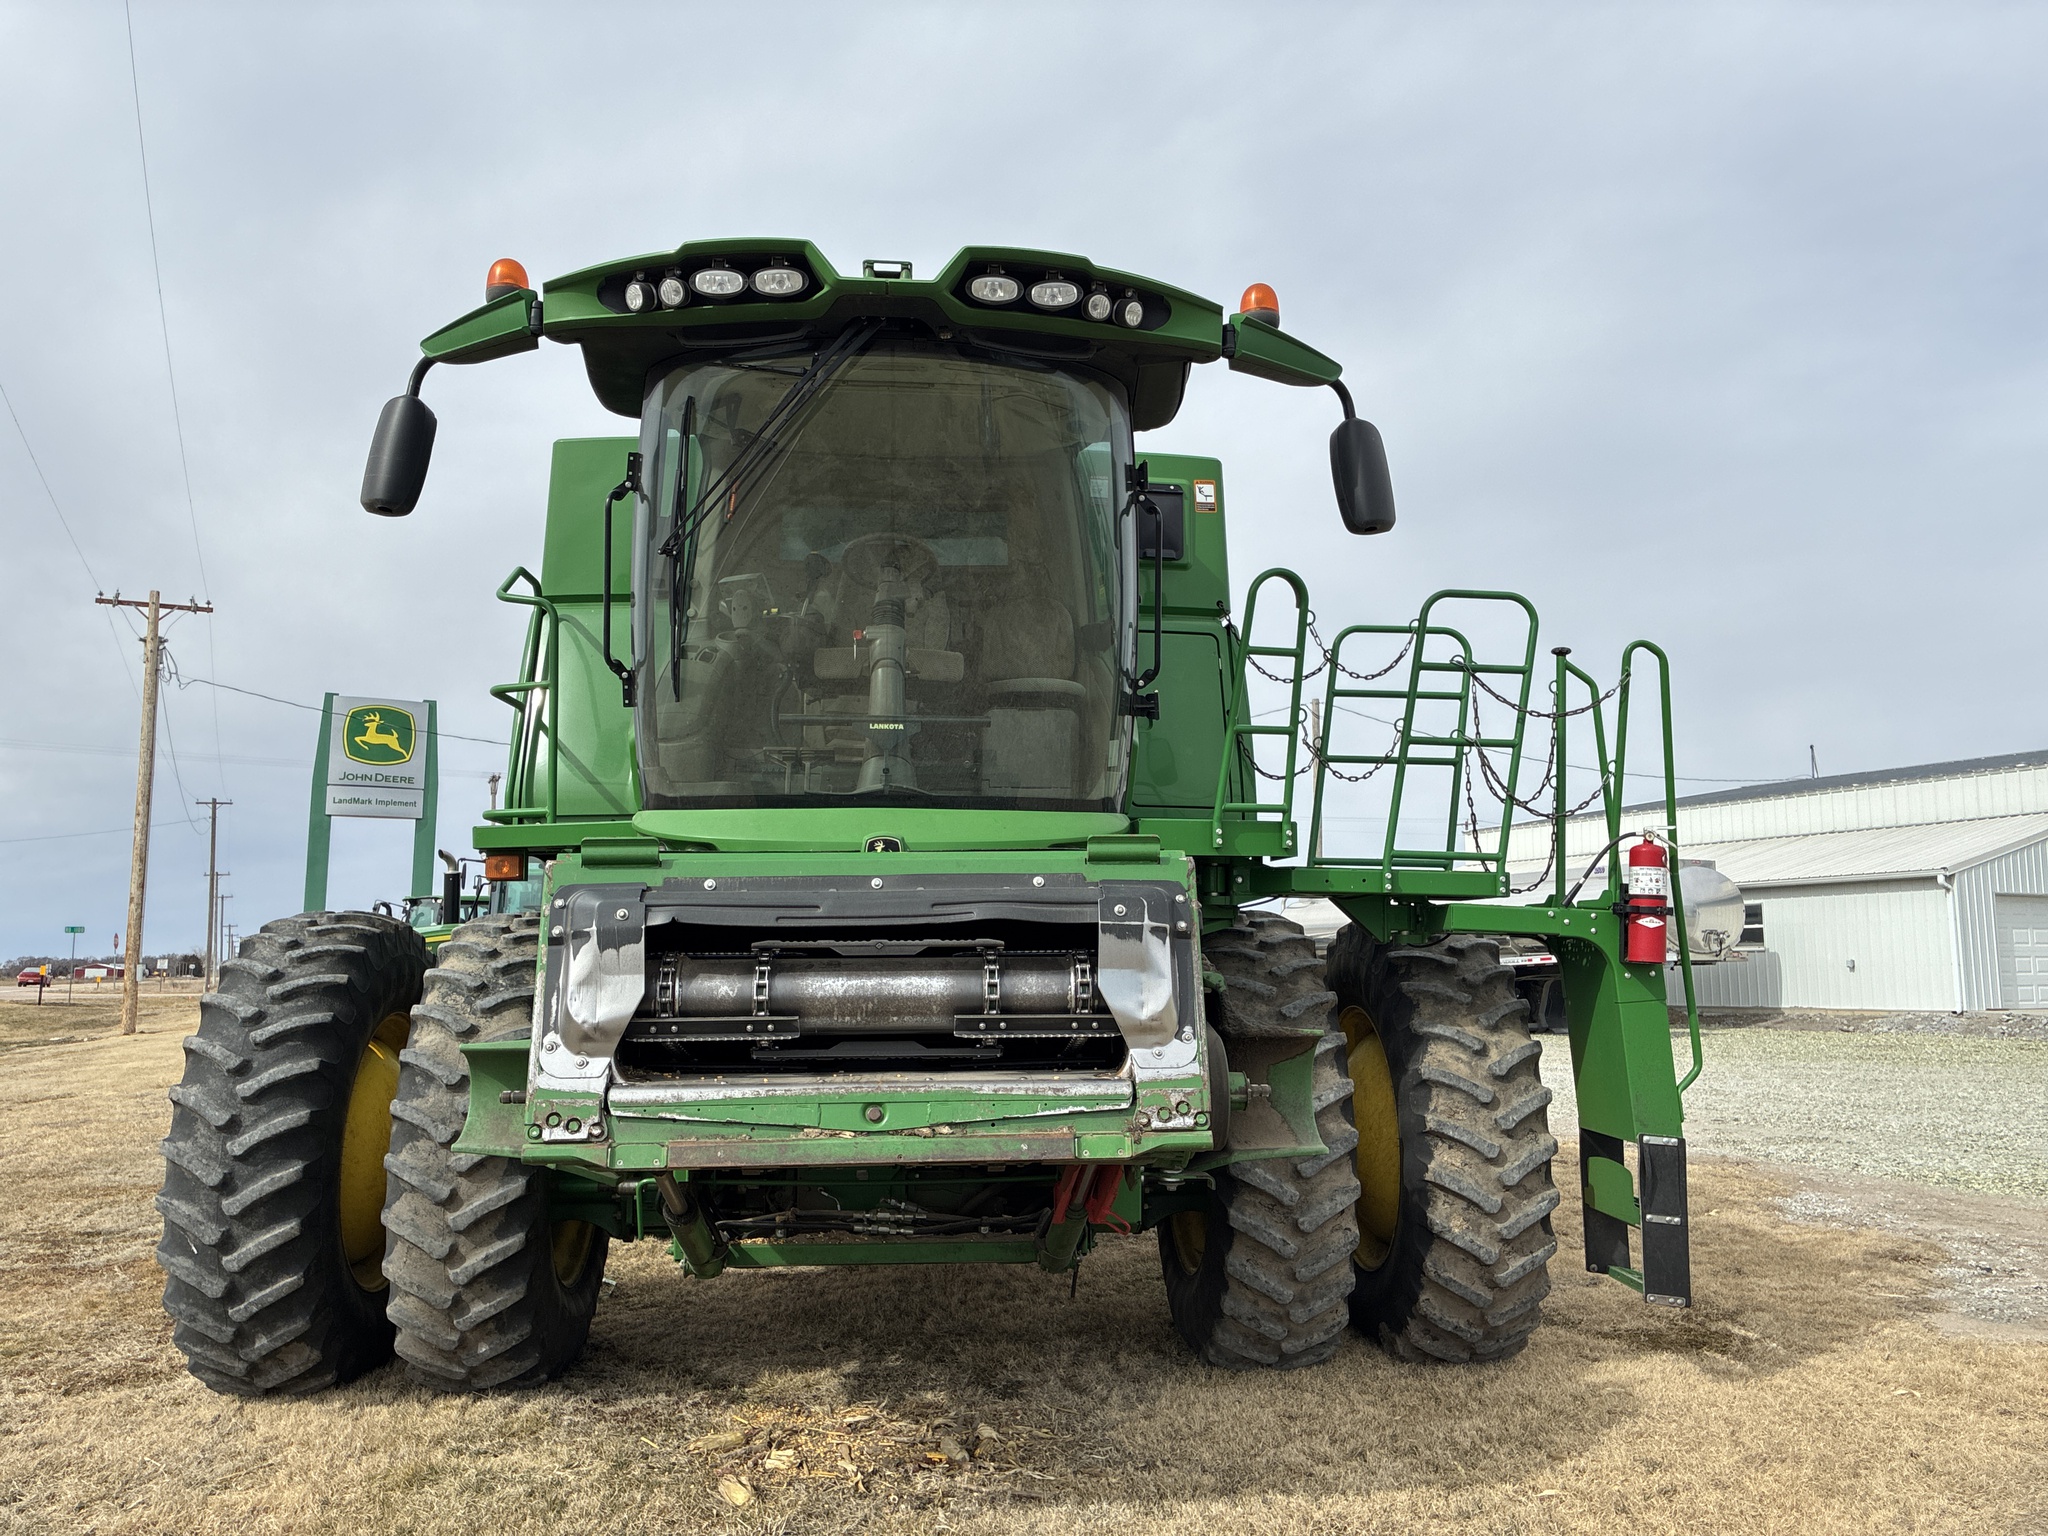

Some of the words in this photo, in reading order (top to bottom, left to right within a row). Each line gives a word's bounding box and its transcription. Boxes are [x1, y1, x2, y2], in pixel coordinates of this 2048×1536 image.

[338, 771, 373, 782] JOHN
[374, 772, 415, 785] DEERE
[332, 796, 373, 806] LandMark
[375, 798, 417, 808] Implement
